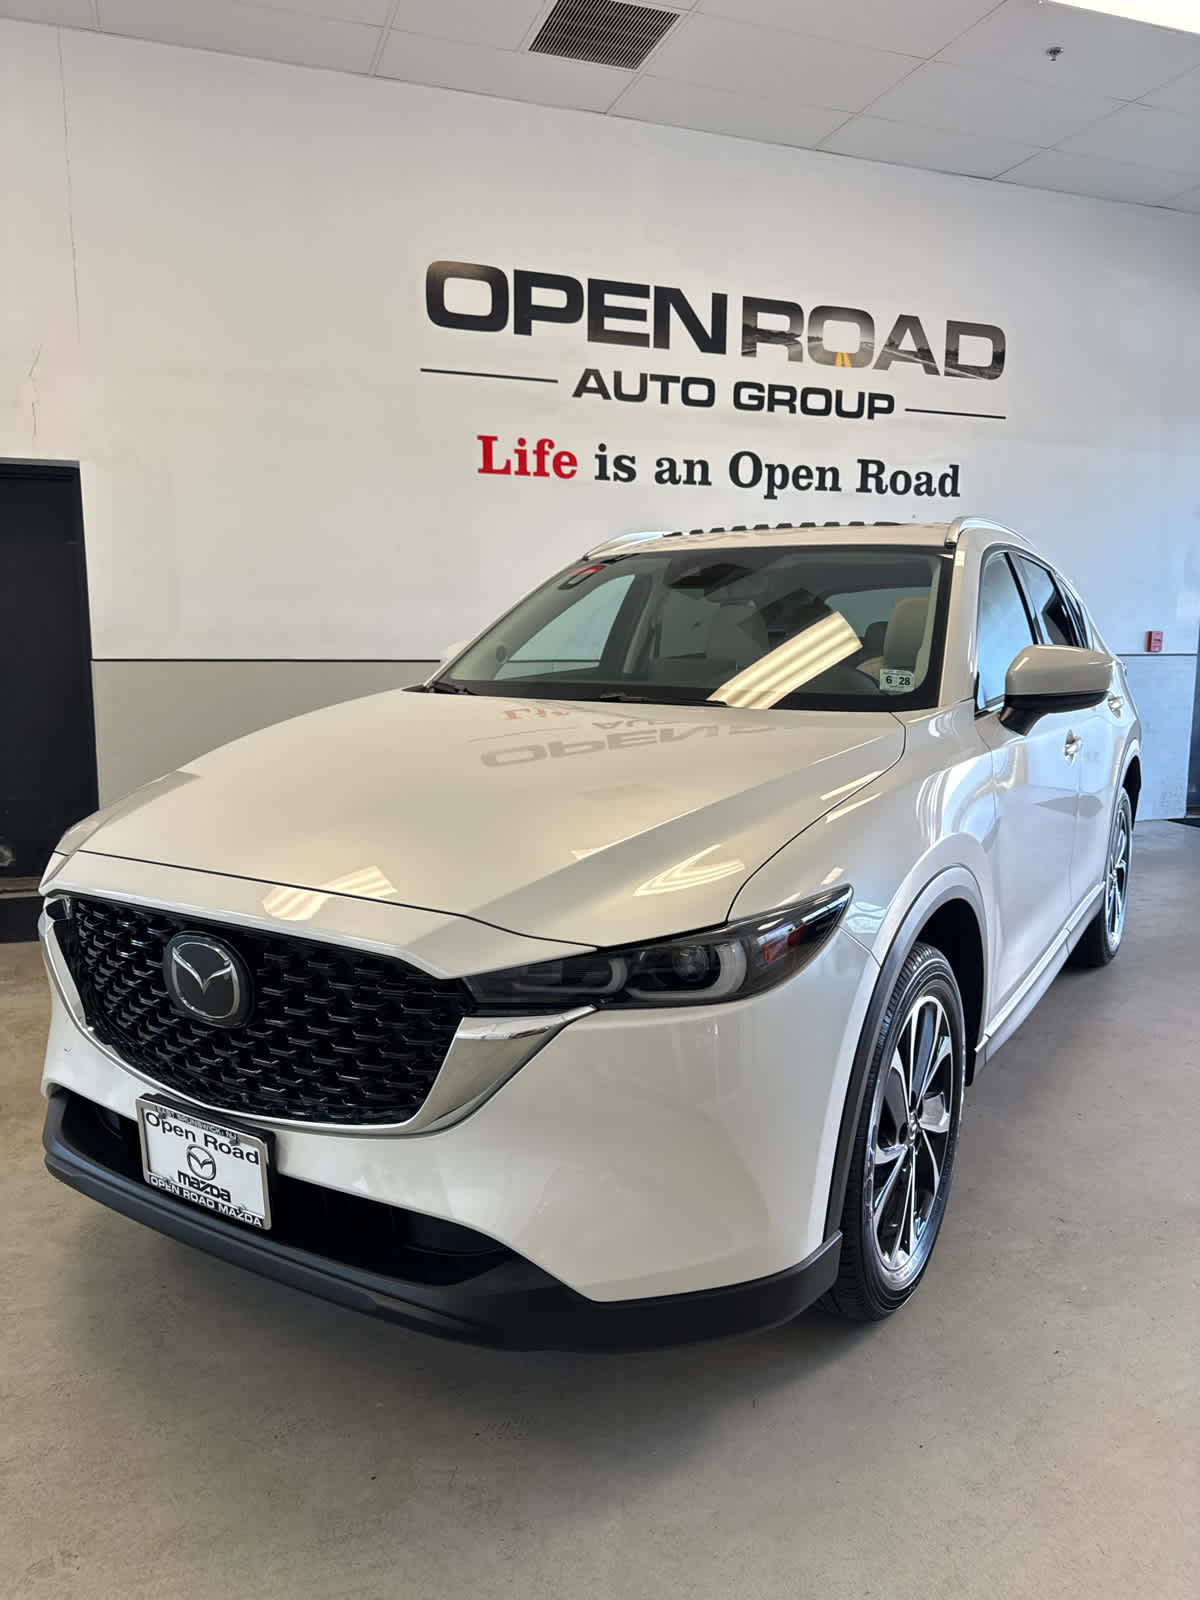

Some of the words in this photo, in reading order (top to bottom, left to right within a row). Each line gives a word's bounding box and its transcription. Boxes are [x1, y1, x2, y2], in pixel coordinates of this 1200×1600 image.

[425, 260, 728, 355] OPEN
[741, 295, 1006, 381] ROAD
[572, 367, 716, 408] AUTO
[732, 380, 895, 420] GROUP
[477, 434, 578, 480] Life
[594, 443, 637, 483] is
[654, 457, 712, 487] an
[728, 450, 842, 500] Open
[855, 458, 961, 498] Road
[886, 675, 893, 685] 6
[898, 676, 911, 686] 28
[145, 1112, 196, 1143] Open
[203, 1134, 259, 1165] Road
[149, 1176, 181, 1195] OPEN
[183, 1189, 216, 1209] ROAD
[218, 1203, 263, 1227] MAZDA
[177, 1170, 231, 1203] mazda
